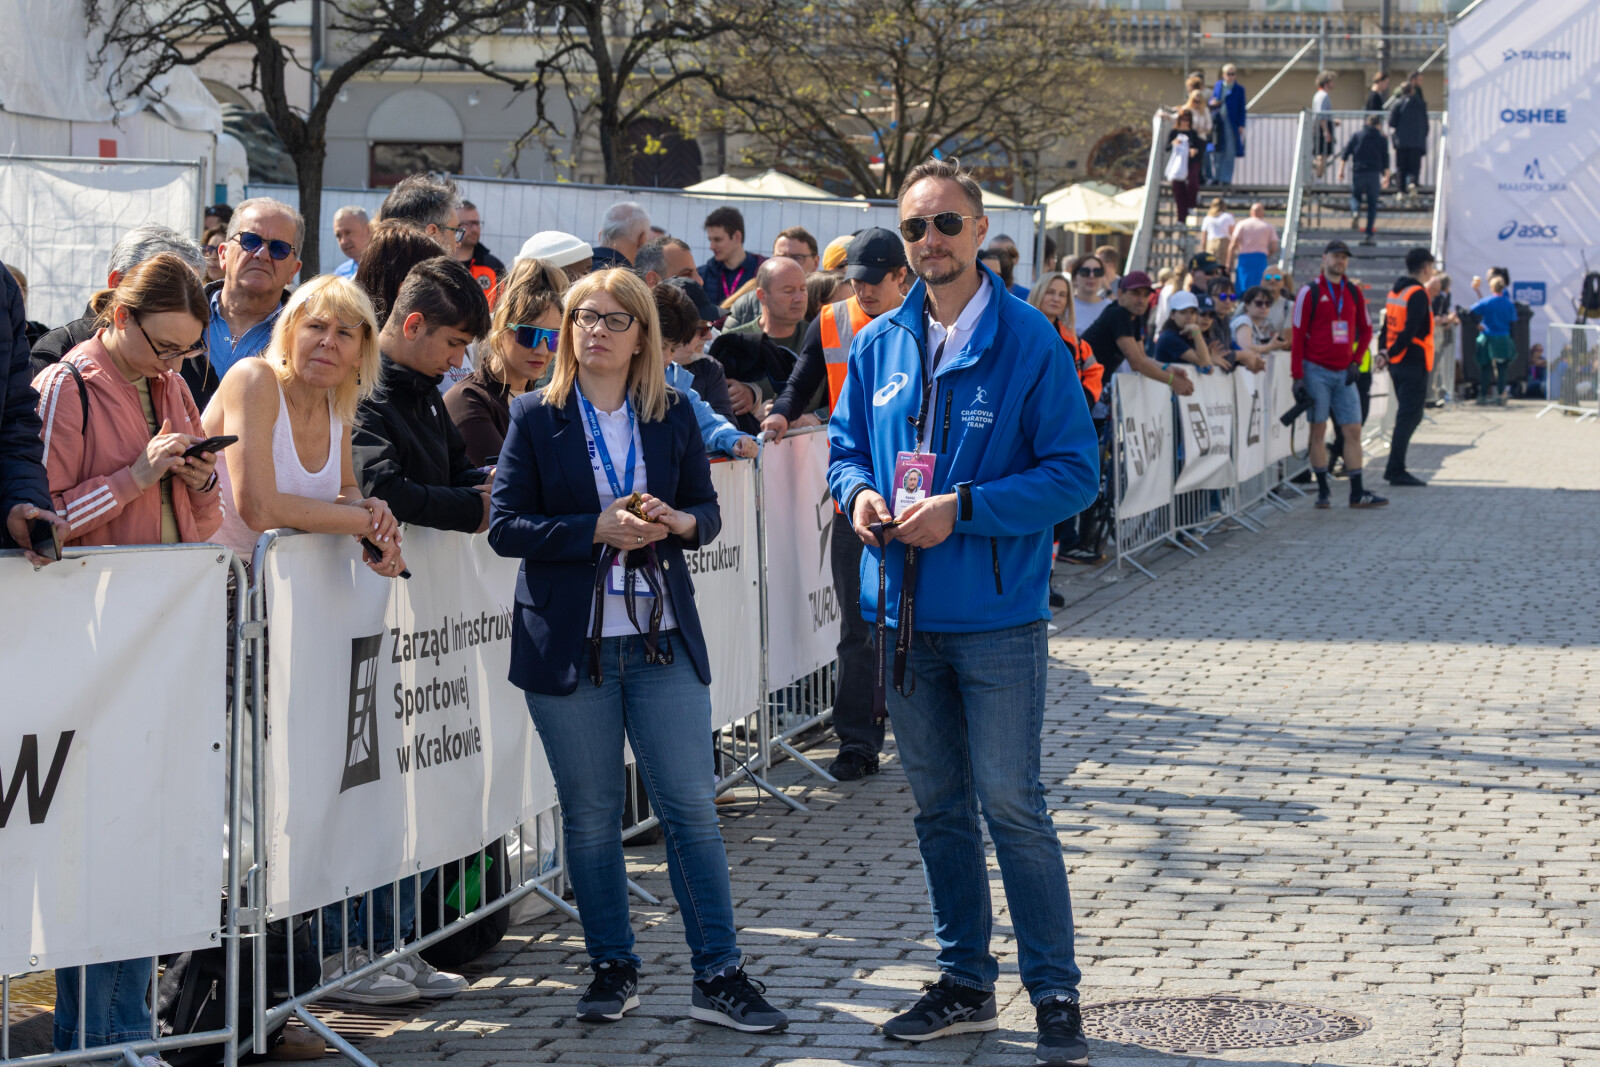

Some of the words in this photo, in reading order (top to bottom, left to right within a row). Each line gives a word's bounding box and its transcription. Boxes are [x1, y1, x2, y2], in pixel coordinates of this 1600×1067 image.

[1521, 51, 1571, 61] TAURON
[1501, 109, 1567, 123] OSHEE
[960, 409, 994, 418] CRACOVIA
[961, 416, 993, 424] MARATON
[967, 421, 984, 429] TEAM
[391, 616, 450, 666] Zarząd
[393, 665, 470, 726] Sportowej
[396, 745, 412, 775] w
[415, 717, 482, 770] Krakowie
